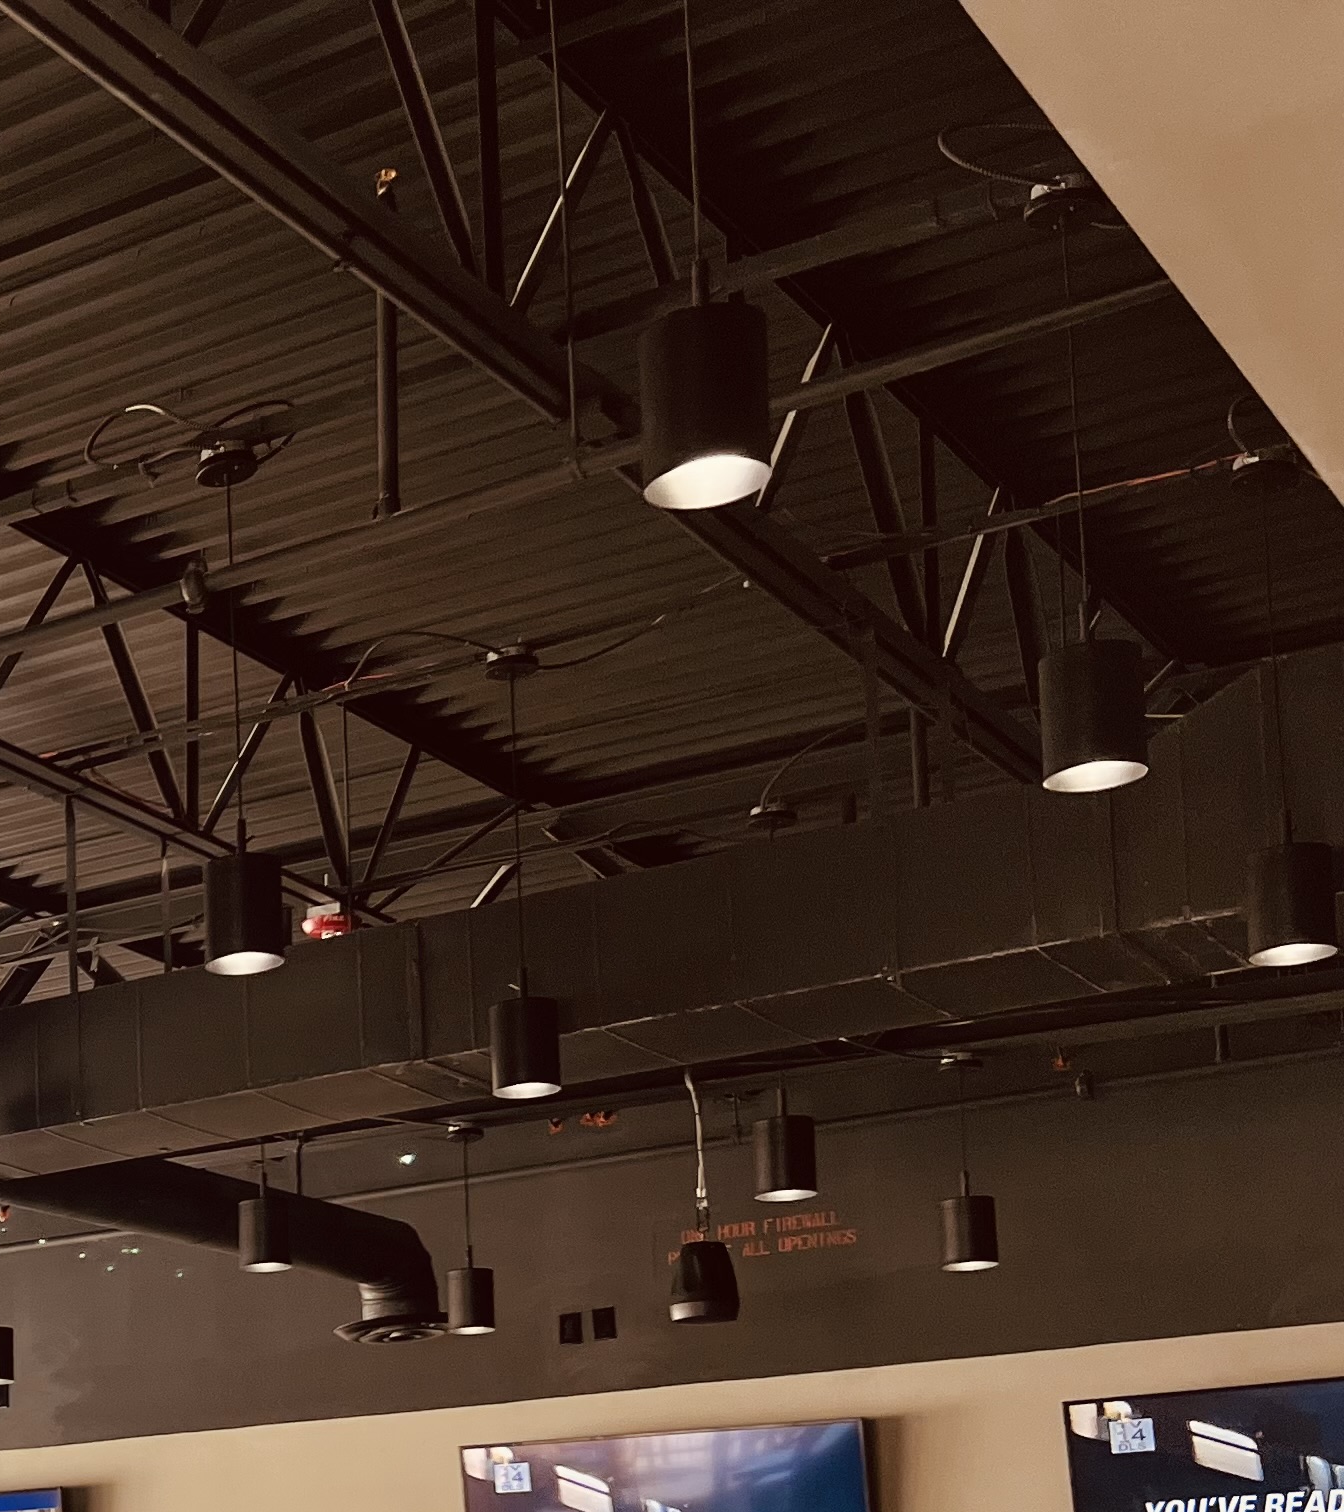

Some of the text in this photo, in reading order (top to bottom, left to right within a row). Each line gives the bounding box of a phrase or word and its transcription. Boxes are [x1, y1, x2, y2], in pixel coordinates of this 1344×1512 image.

[717, 1221, 756, 1240] HOUR
[764, 1211, 837, 1234] FIREWALL
[742, 1228, 857, 1257] ALL OPENINGS
